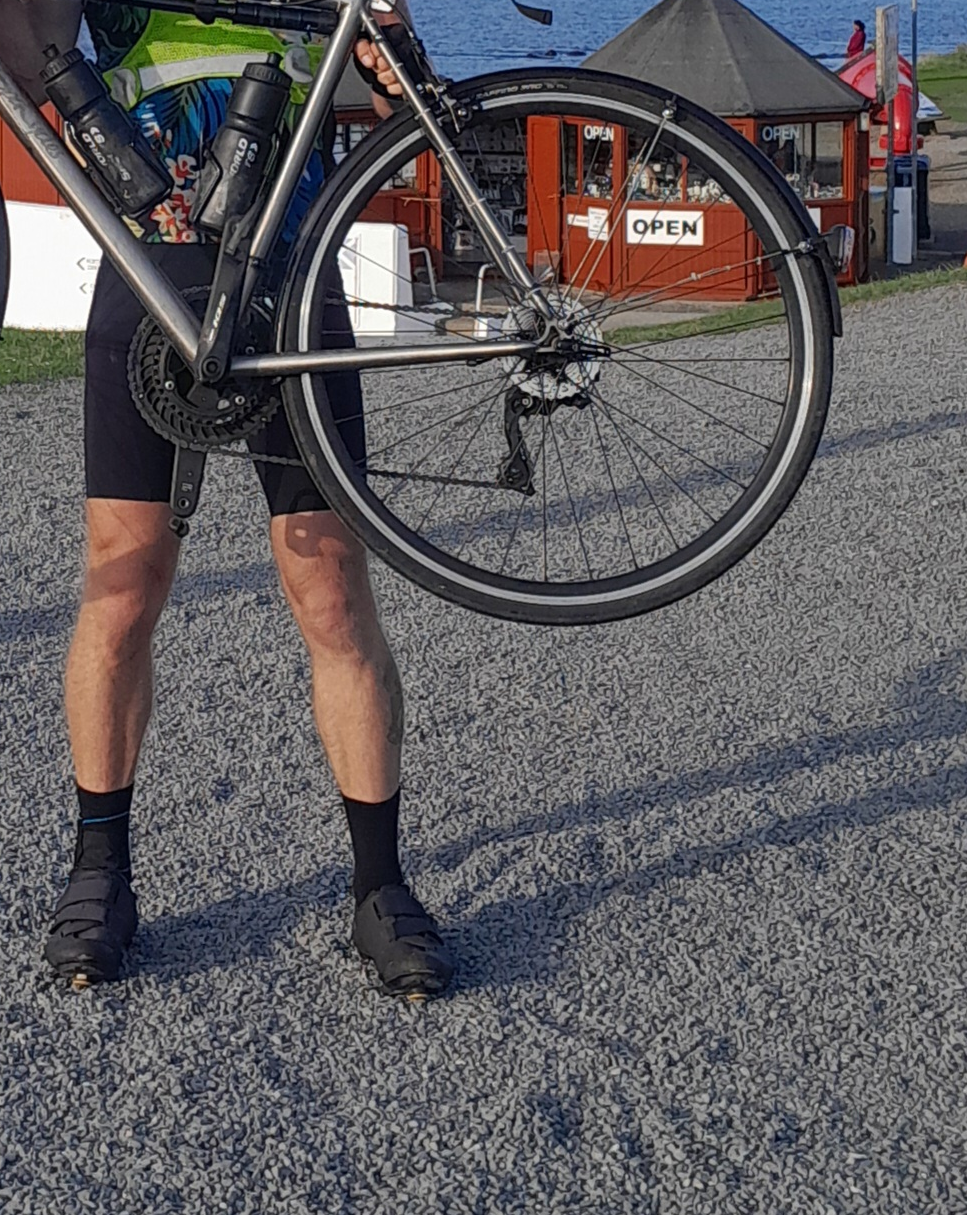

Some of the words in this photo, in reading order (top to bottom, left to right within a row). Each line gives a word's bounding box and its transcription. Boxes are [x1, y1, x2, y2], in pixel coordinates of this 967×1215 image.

[584, 125, 614, 141] OPEN
[762, 126, 800, 141] OPEN
[229, 137, 248, 176] ORLD
[632, 218, 698, 236] OPEN
